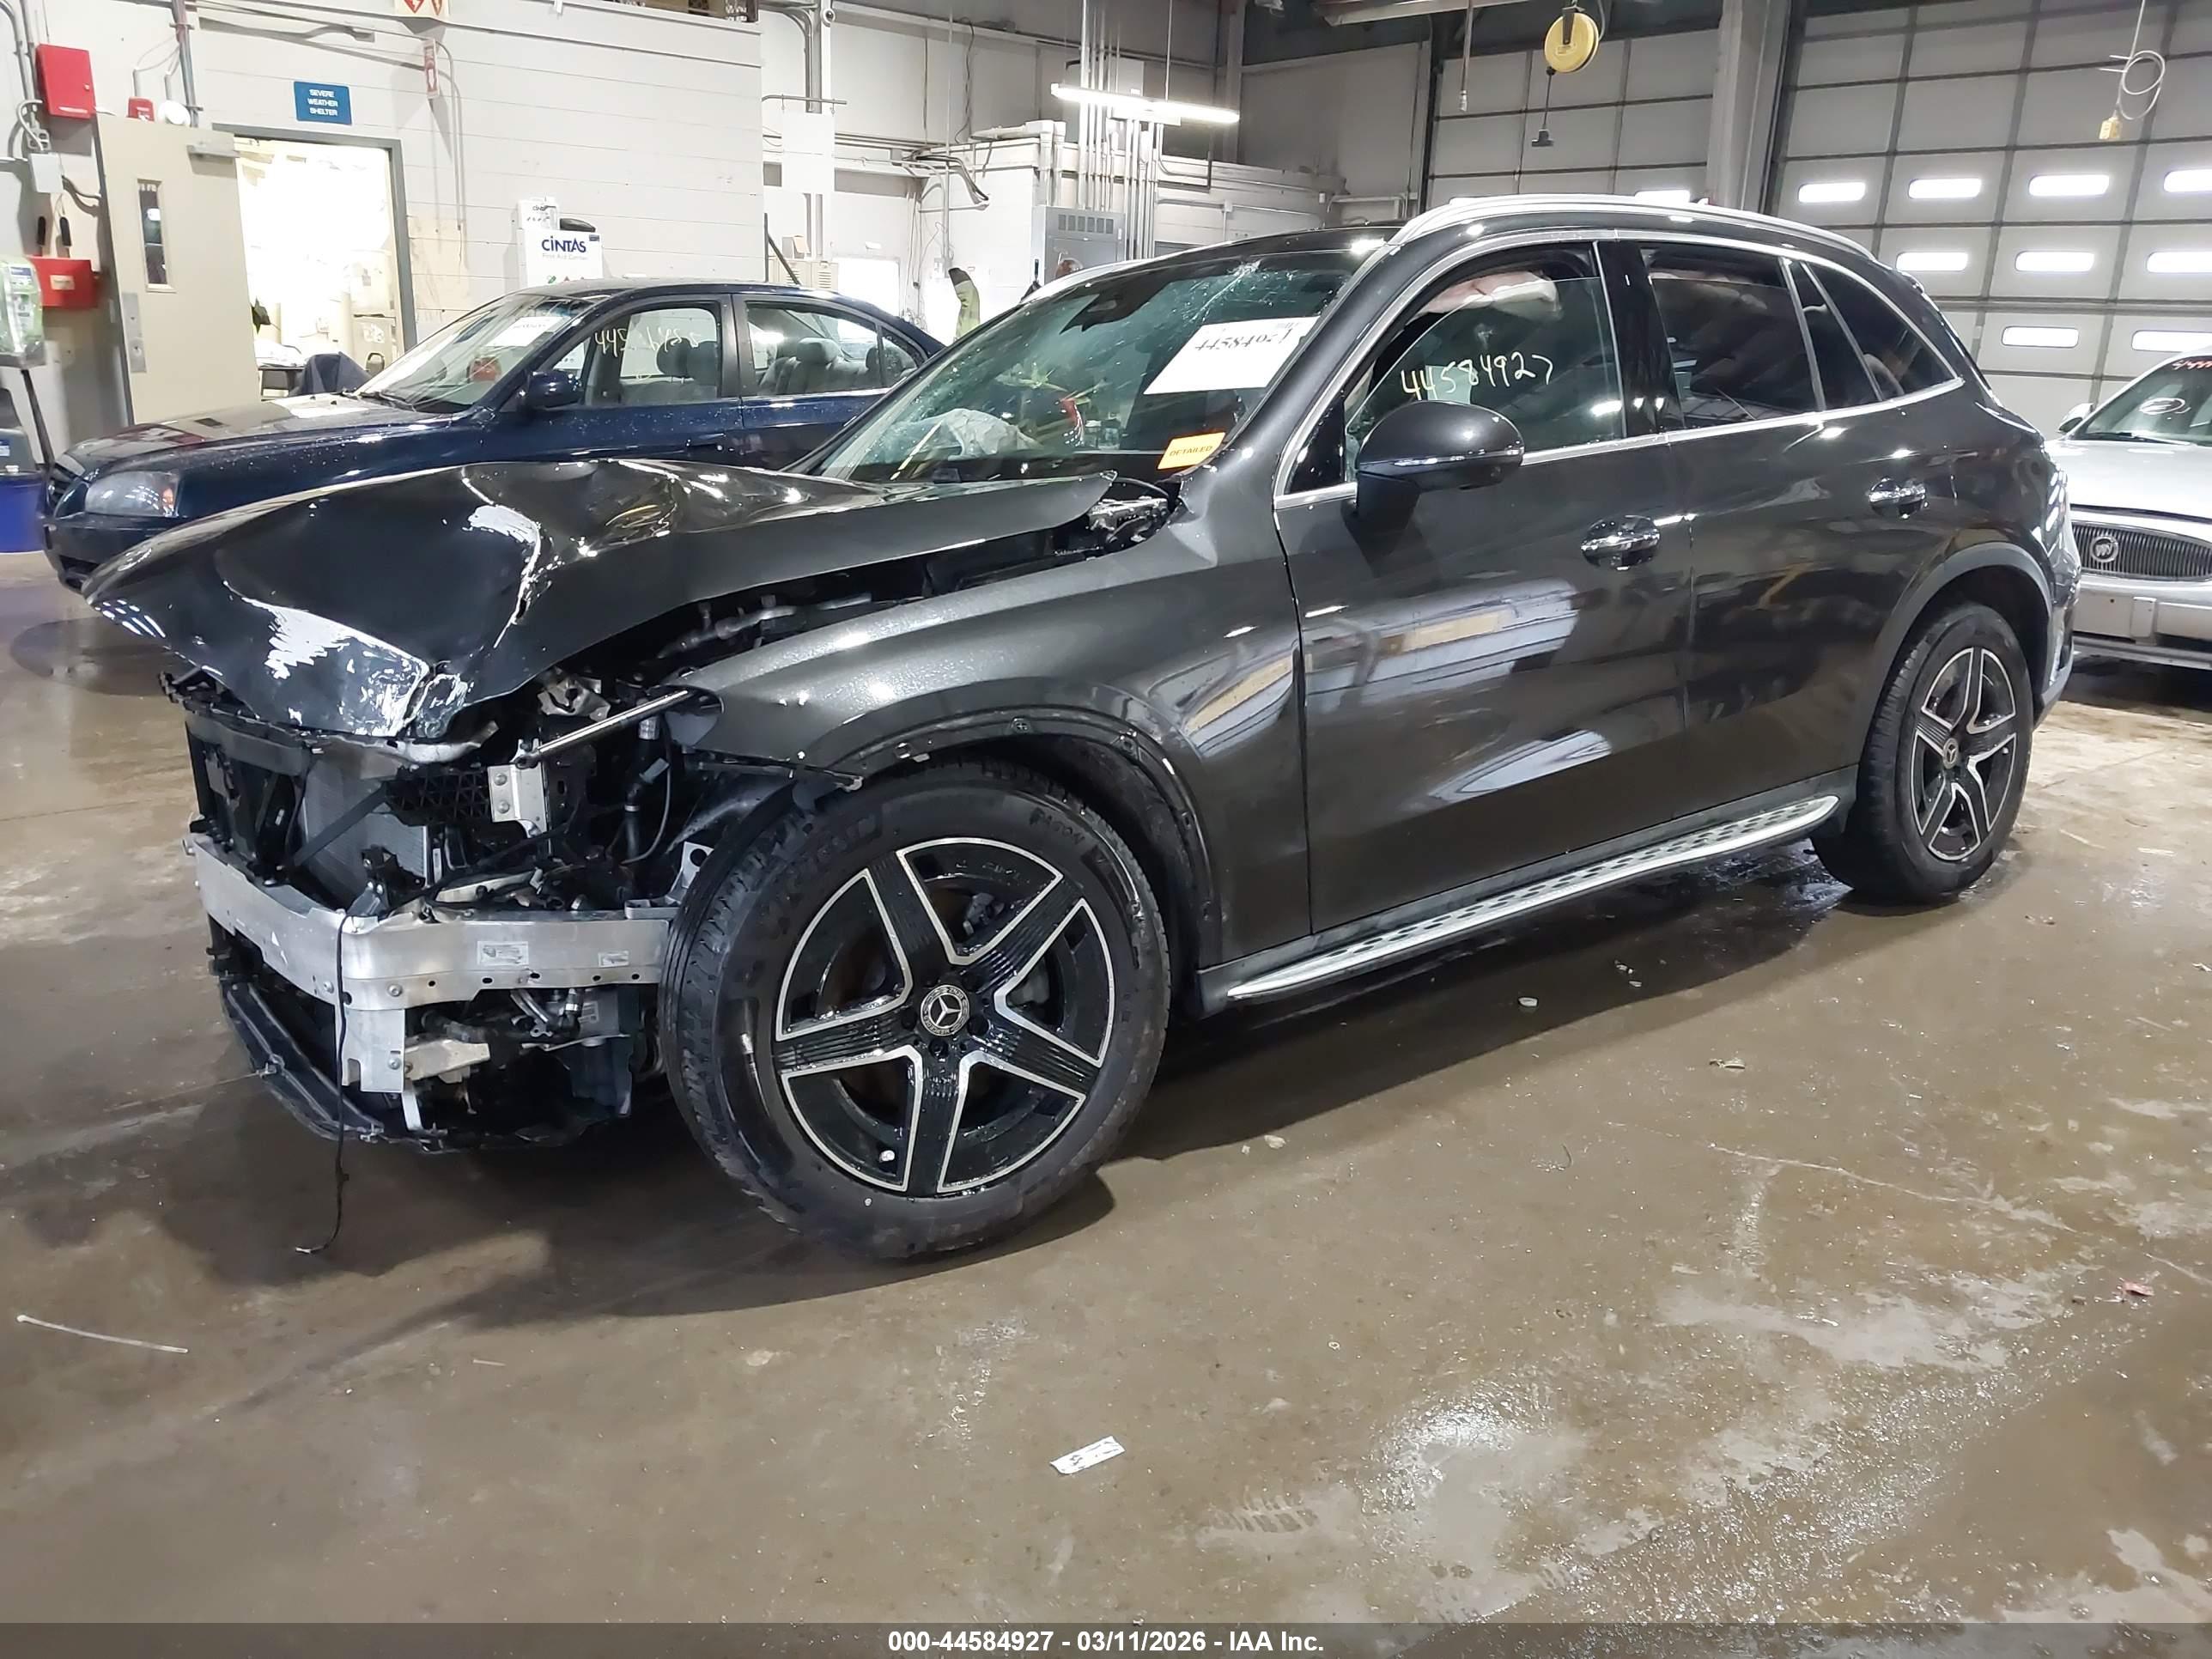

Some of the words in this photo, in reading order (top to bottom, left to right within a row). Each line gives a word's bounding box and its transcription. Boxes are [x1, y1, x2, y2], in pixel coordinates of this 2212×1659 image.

[309, 88, 335, 98] SEVERE
[307, 97, 338, 107] WEATHER
[309, 106, 337, 117] SHELTER
[541, 235, 586, 253] CINTAS
[1401, 351, 1554, 401] 44584927
[1169, 445, 1213, 457] DETAILED
